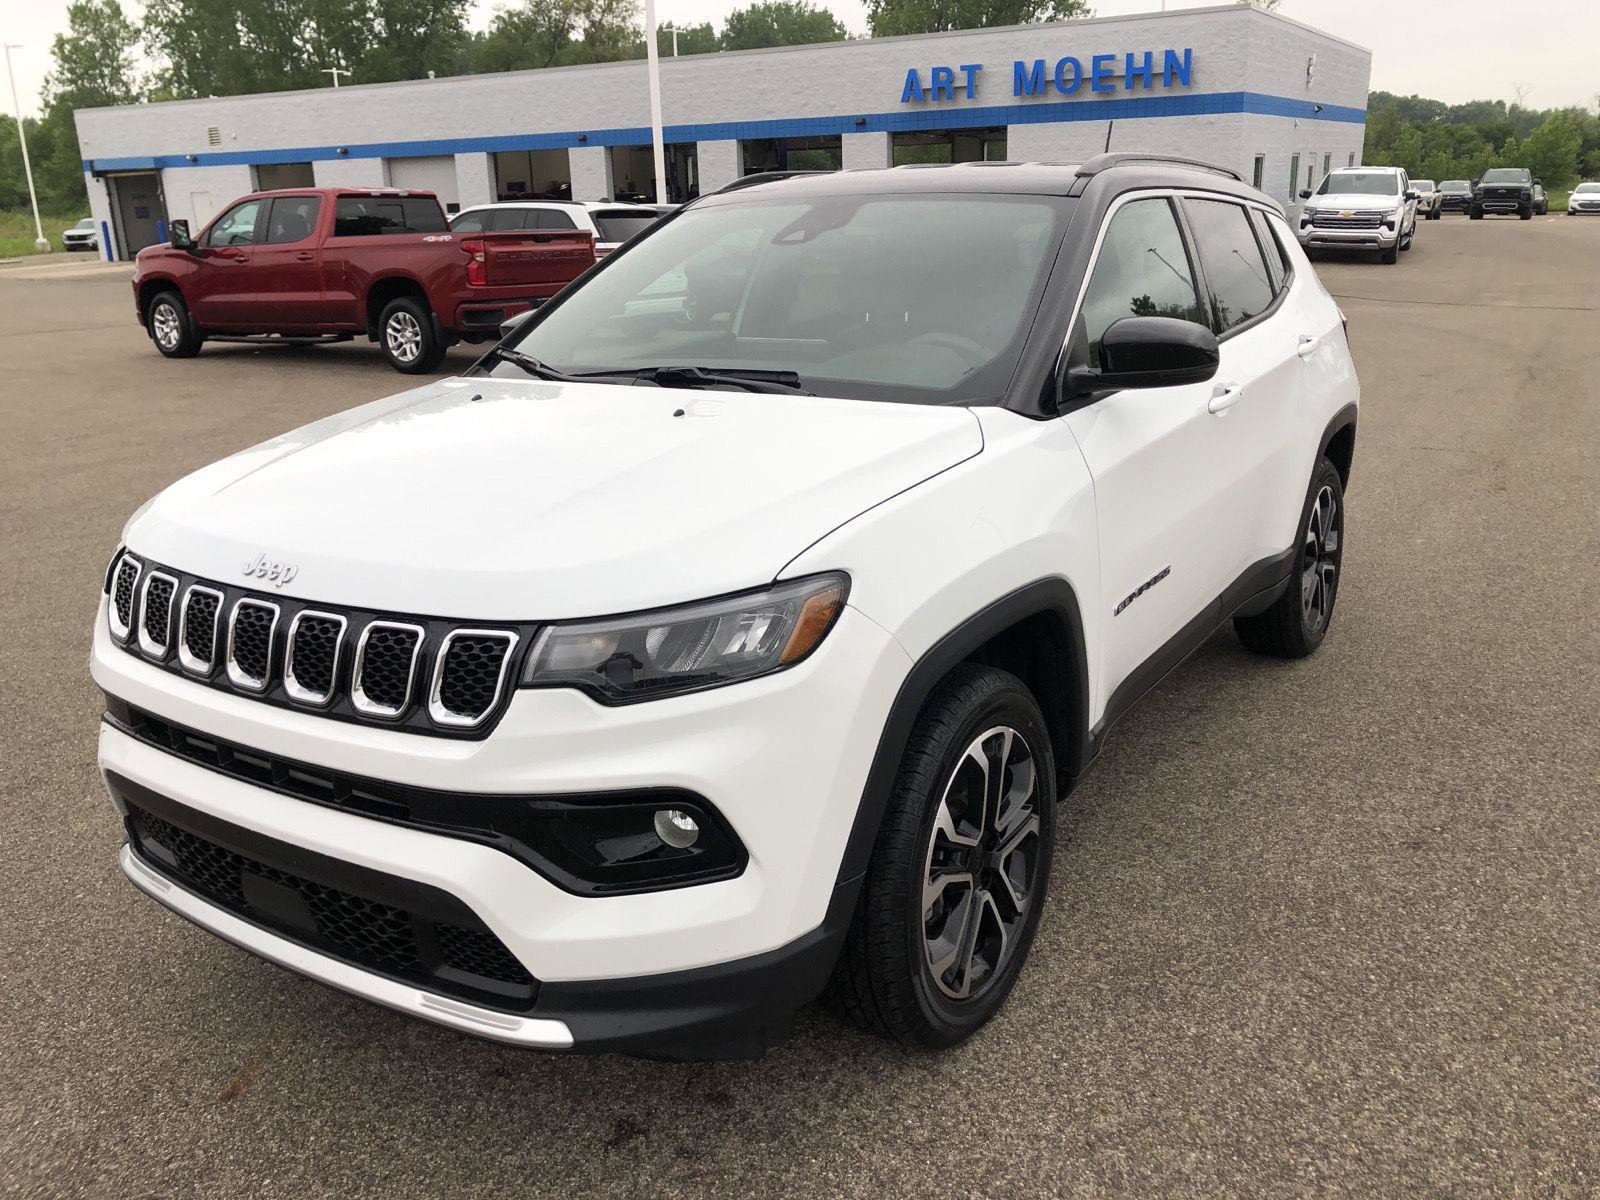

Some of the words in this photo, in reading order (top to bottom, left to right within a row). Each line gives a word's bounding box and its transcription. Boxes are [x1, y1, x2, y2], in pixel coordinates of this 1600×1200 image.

[901, 64, 984, 103] ART
[1013, 48, 1192, 97] MOEHN
[242, 553, 298, 589] Jeep
